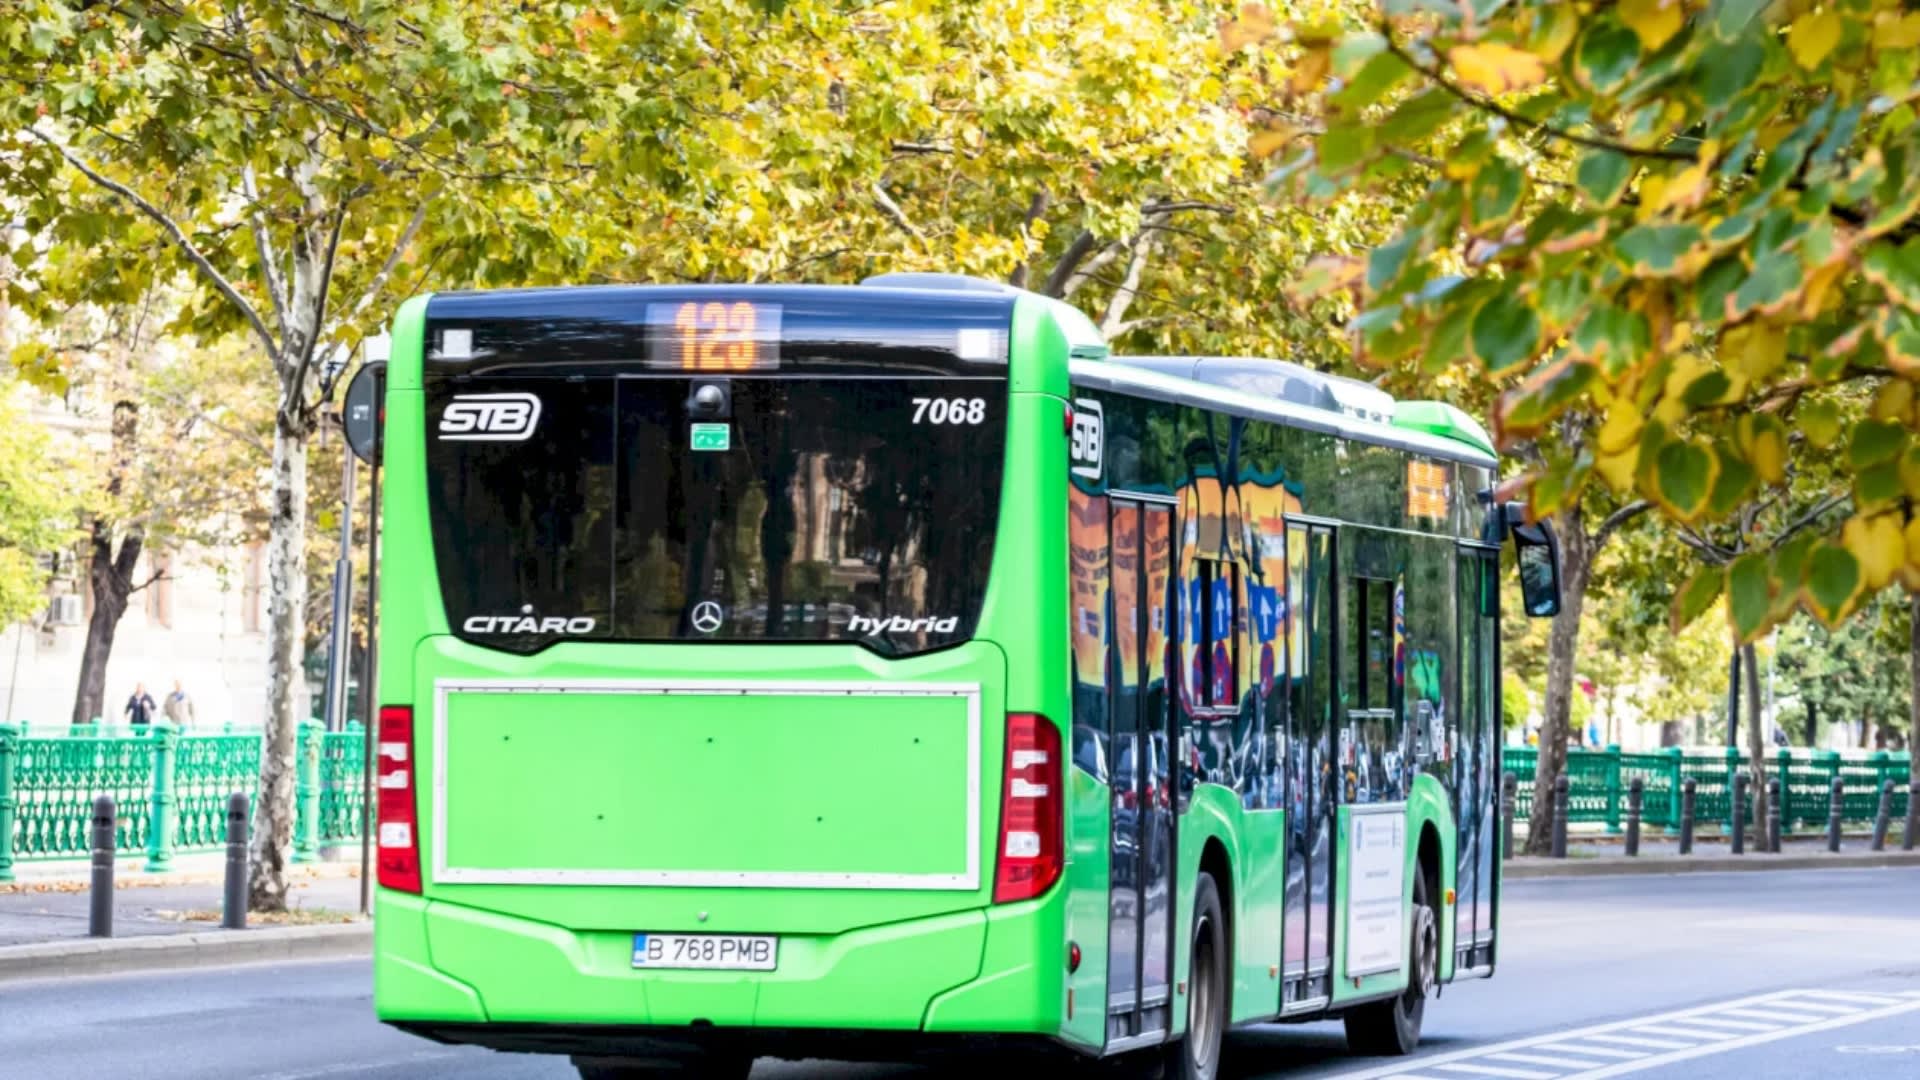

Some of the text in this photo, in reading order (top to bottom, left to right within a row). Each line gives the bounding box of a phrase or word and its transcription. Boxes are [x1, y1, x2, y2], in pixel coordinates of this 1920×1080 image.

[675, 302, 755, 369] 123
[439, 402, 531, 431] STB
[912, 397, 986, 425] 7068
[1071, 412, 1100, 462] STB
[847, 615, 958, 636] hybrid
[648, 938, 769, 962] B 768 PMB
